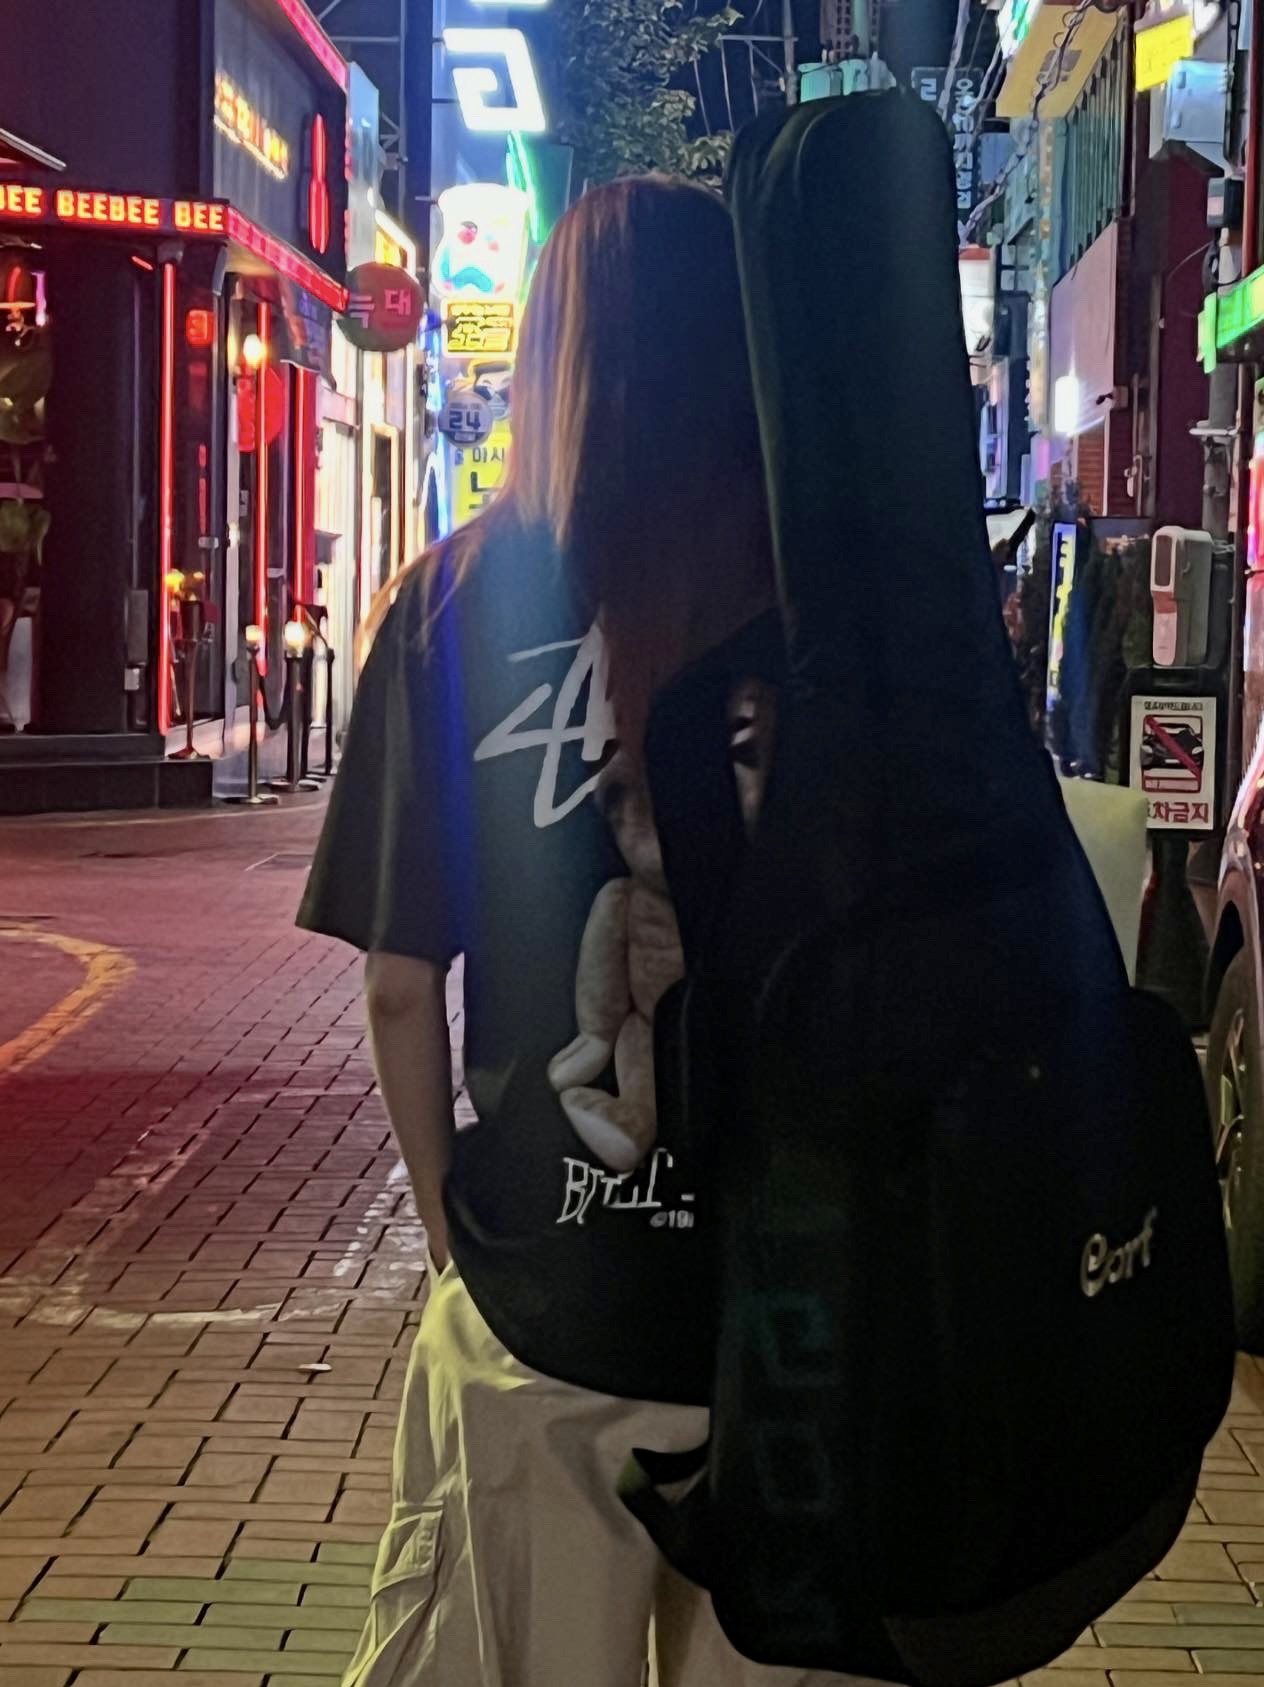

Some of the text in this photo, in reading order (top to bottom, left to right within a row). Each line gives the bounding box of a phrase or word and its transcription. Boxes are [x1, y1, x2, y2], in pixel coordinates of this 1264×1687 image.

[0, 184, 42, 213] EE
[449, 410, 481, 430] 24
[1147, 801, 1209, 823] 차금지
